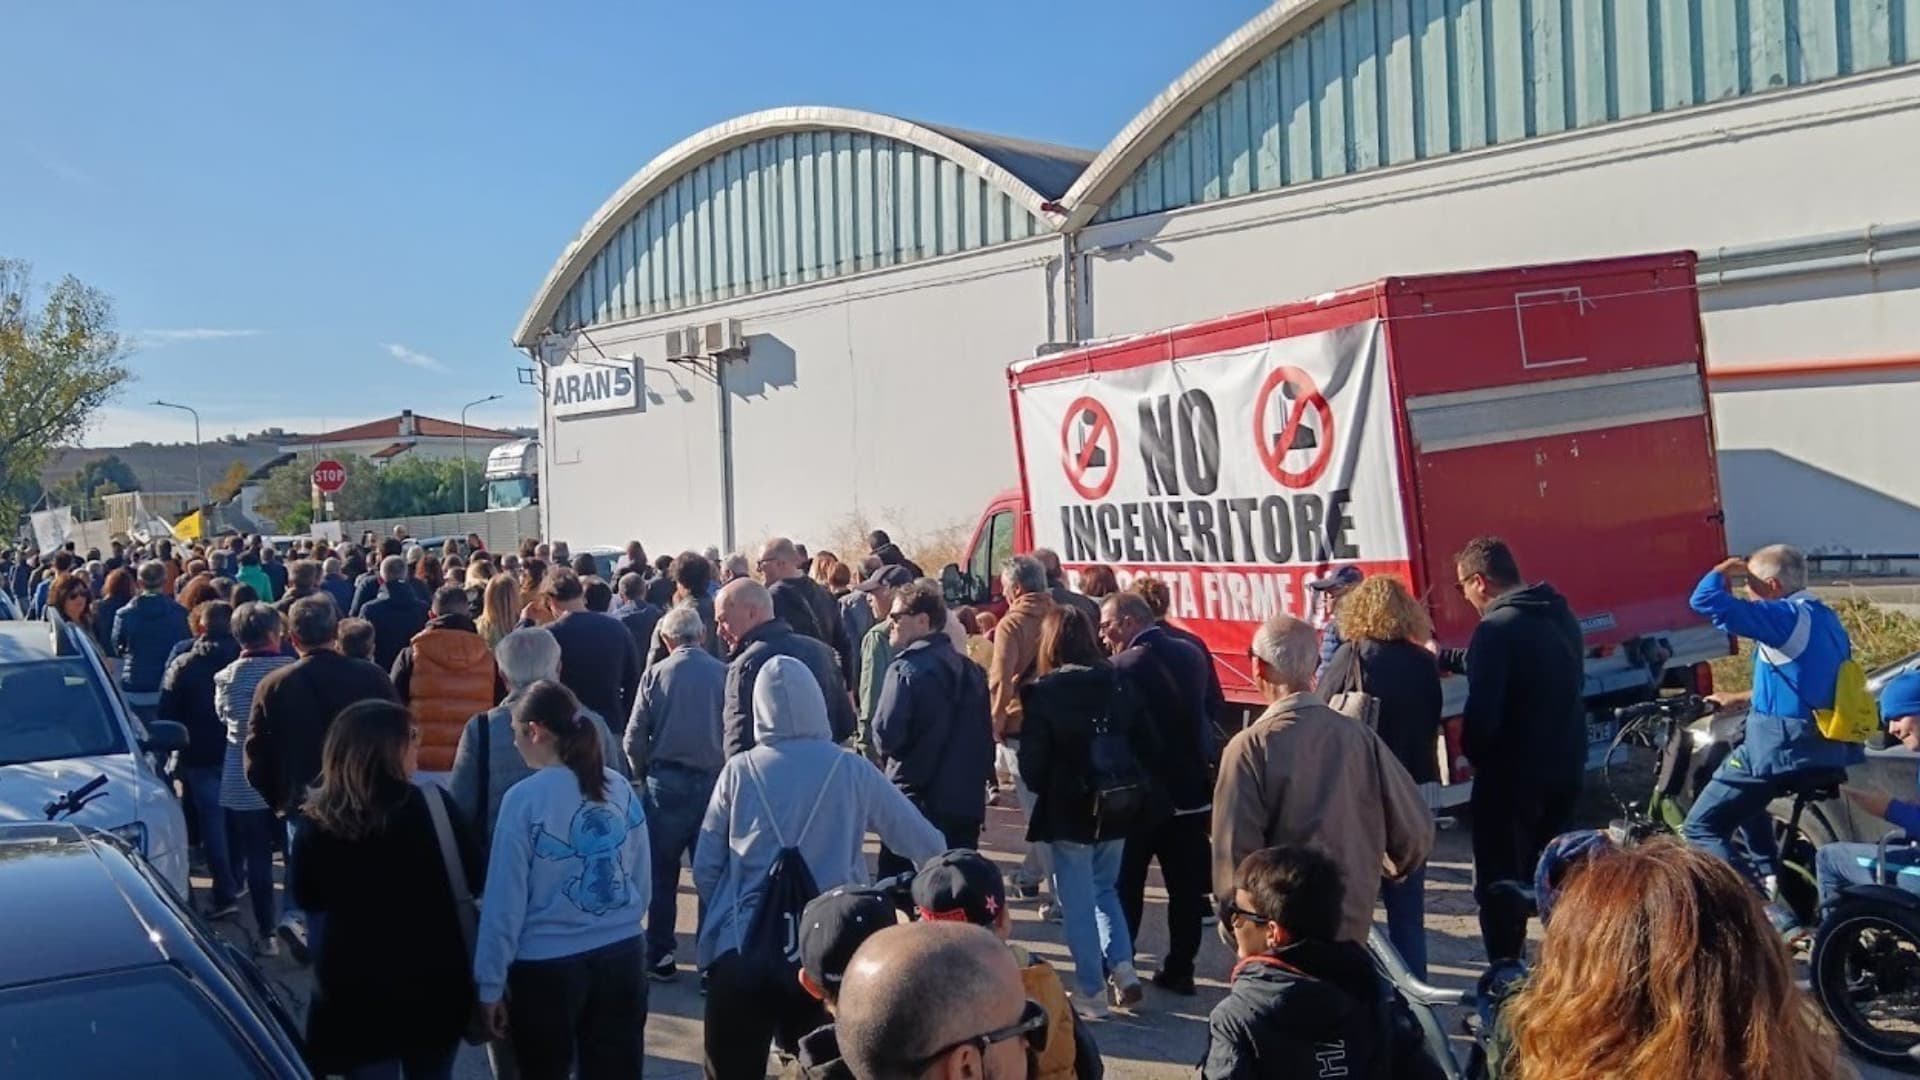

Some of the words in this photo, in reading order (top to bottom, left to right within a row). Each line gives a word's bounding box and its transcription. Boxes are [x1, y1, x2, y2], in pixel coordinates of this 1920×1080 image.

[1137, 388, 1221, 497] NO
[314, 469, 344, 482] STOP
[1060, 488, 1361, 564] INCENERITORE
[1203, 570, 1296, 622] FIRME
